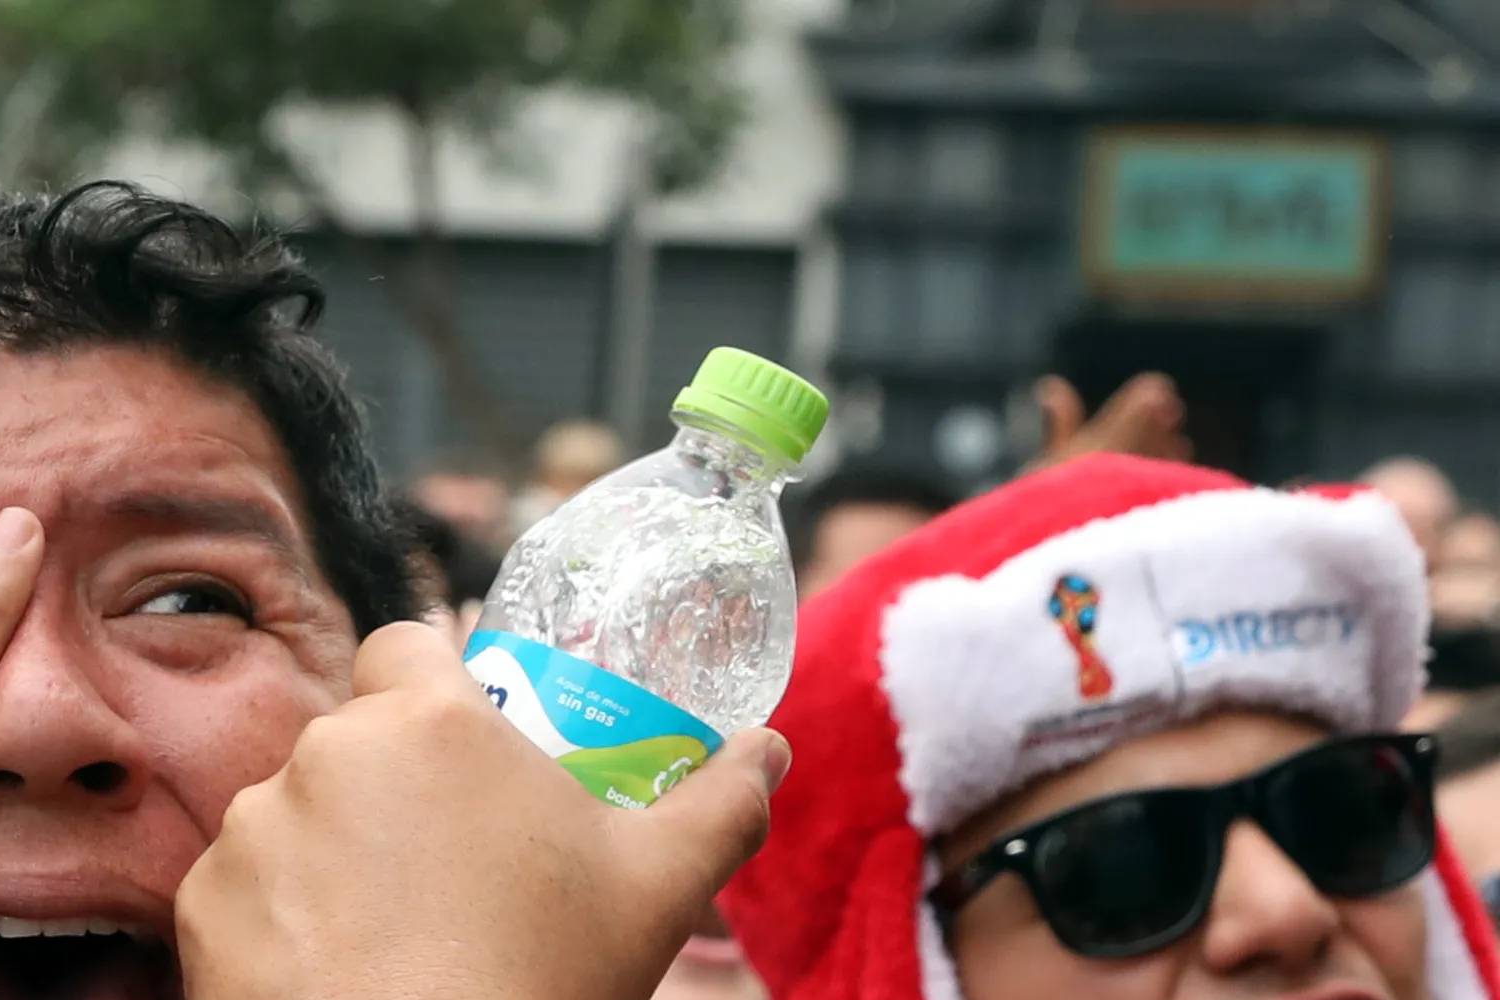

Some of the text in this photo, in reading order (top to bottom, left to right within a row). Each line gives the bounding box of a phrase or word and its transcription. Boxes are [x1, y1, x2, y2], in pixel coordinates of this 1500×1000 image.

[555, 676, 630, 717] Agua de mesa
[556, 692, 616, 728] sin gas
